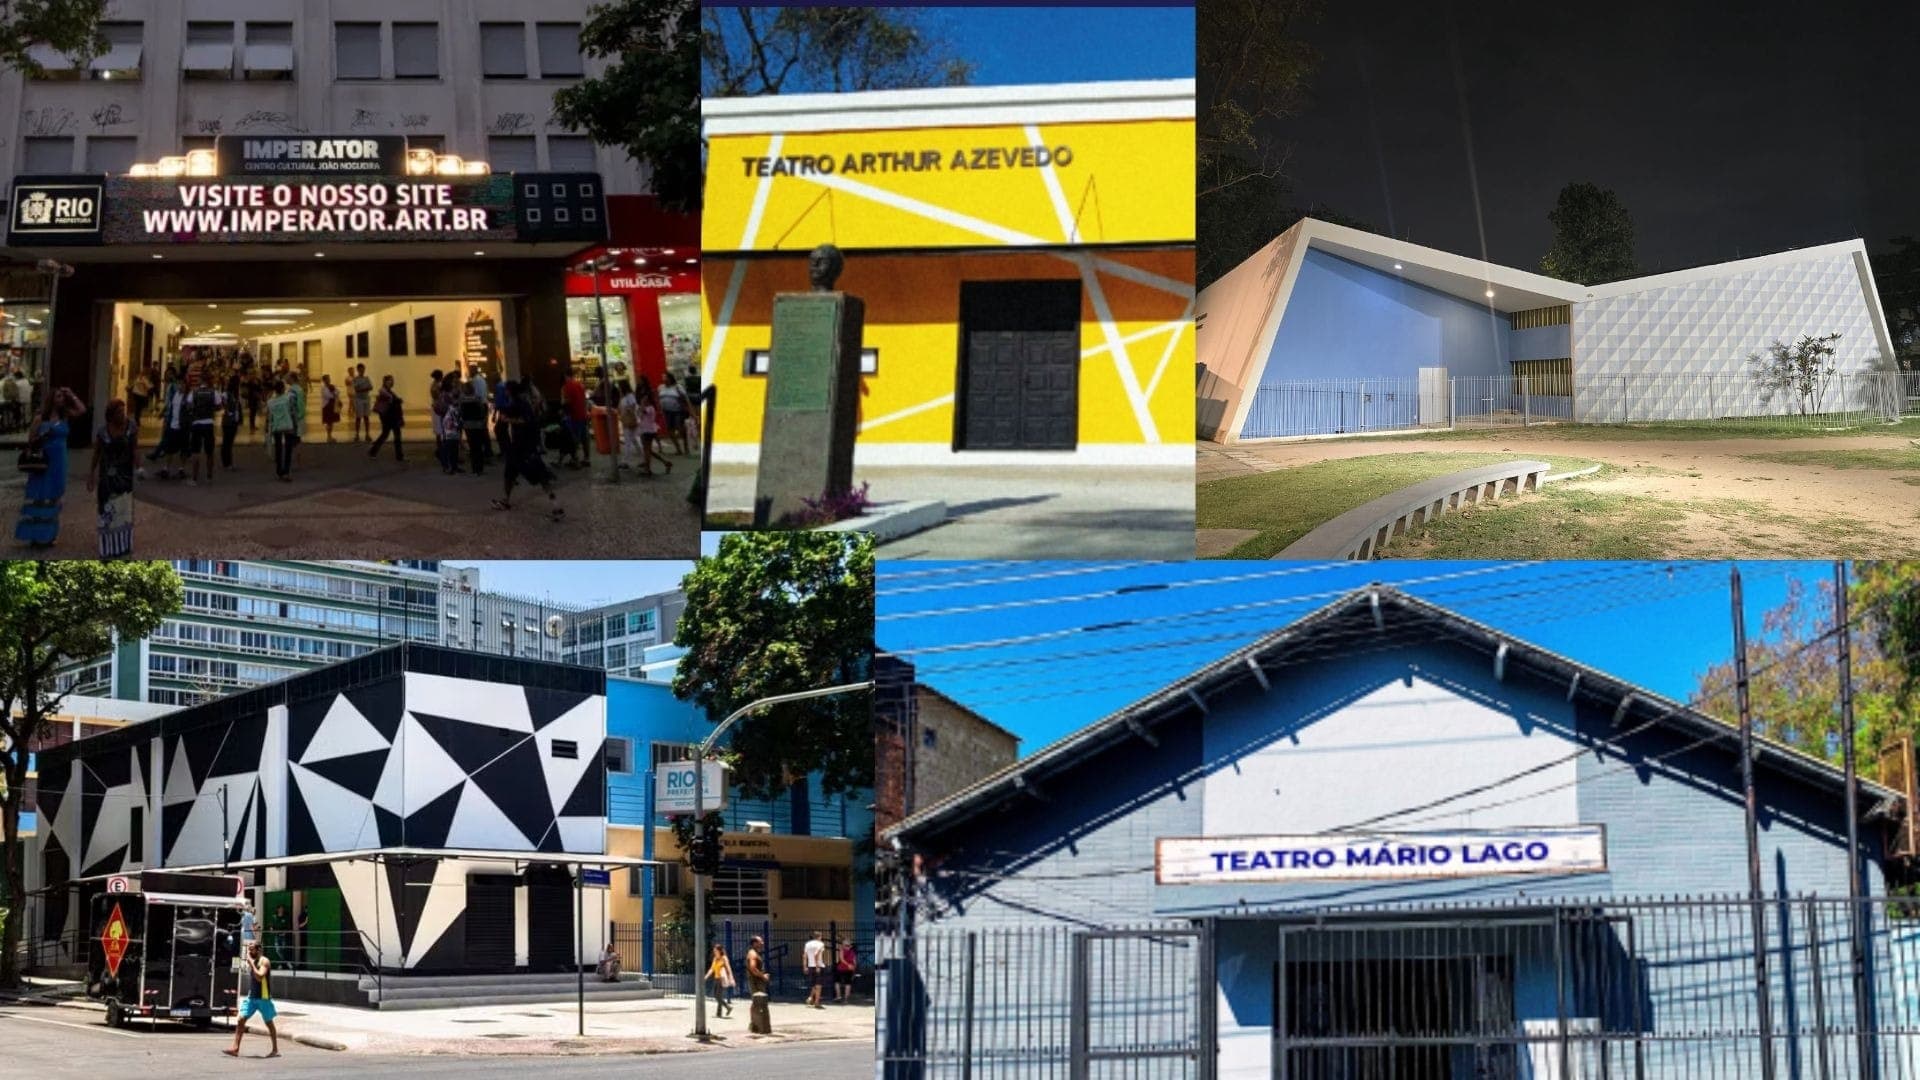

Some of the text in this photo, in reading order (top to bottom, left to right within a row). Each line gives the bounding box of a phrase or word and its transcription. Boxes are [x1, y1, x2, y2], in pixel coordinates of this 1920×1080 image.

[243, 140, 379, 159] IMPERATOR
[245, 159, 380, 170] CENTRO CULTURAL JOÃO NOGUEIRA
[742, 146, 1073, 177] TEATRO ARTHUR AZEVEDO
[179, 184, 452, 207] VISITE O NOSSO SITE
[55, 198, 93, 217] RIO
[143, 208, 488, 233] WWW.IMPERATOR.ART.BR
[610, 277, 672, 288] UTILICASA
[667, 770, 697, 788] RIO
[667, 787, 709, 795] PREFEITA
[1210, 840, 1549, 873] TEATRO MÁRIO LAGO
[115, 882, 122, 892] E
